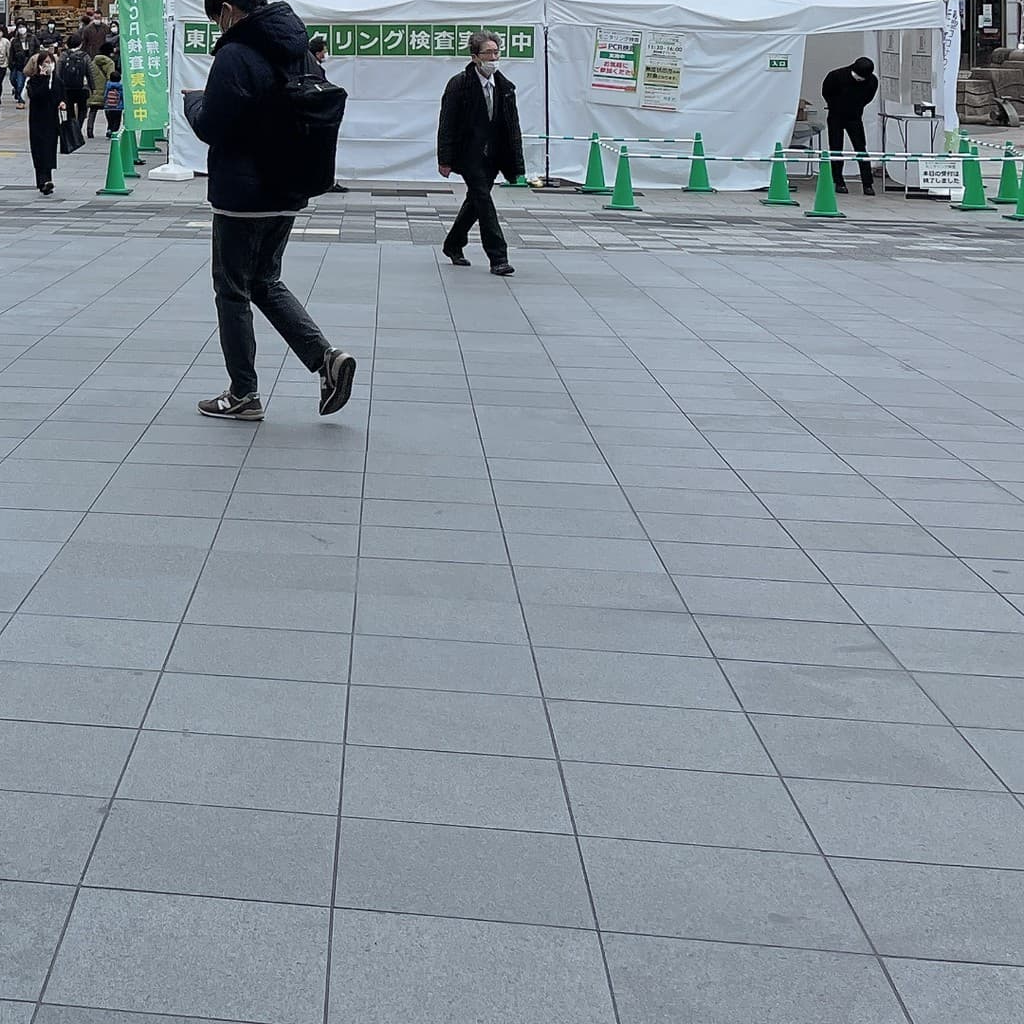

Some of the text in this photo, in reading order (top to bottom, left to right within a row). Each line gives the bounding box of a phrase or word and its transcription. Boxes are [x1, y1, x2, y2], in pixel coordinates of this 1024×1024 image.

[922, 177, 961, 186] 終了しました
